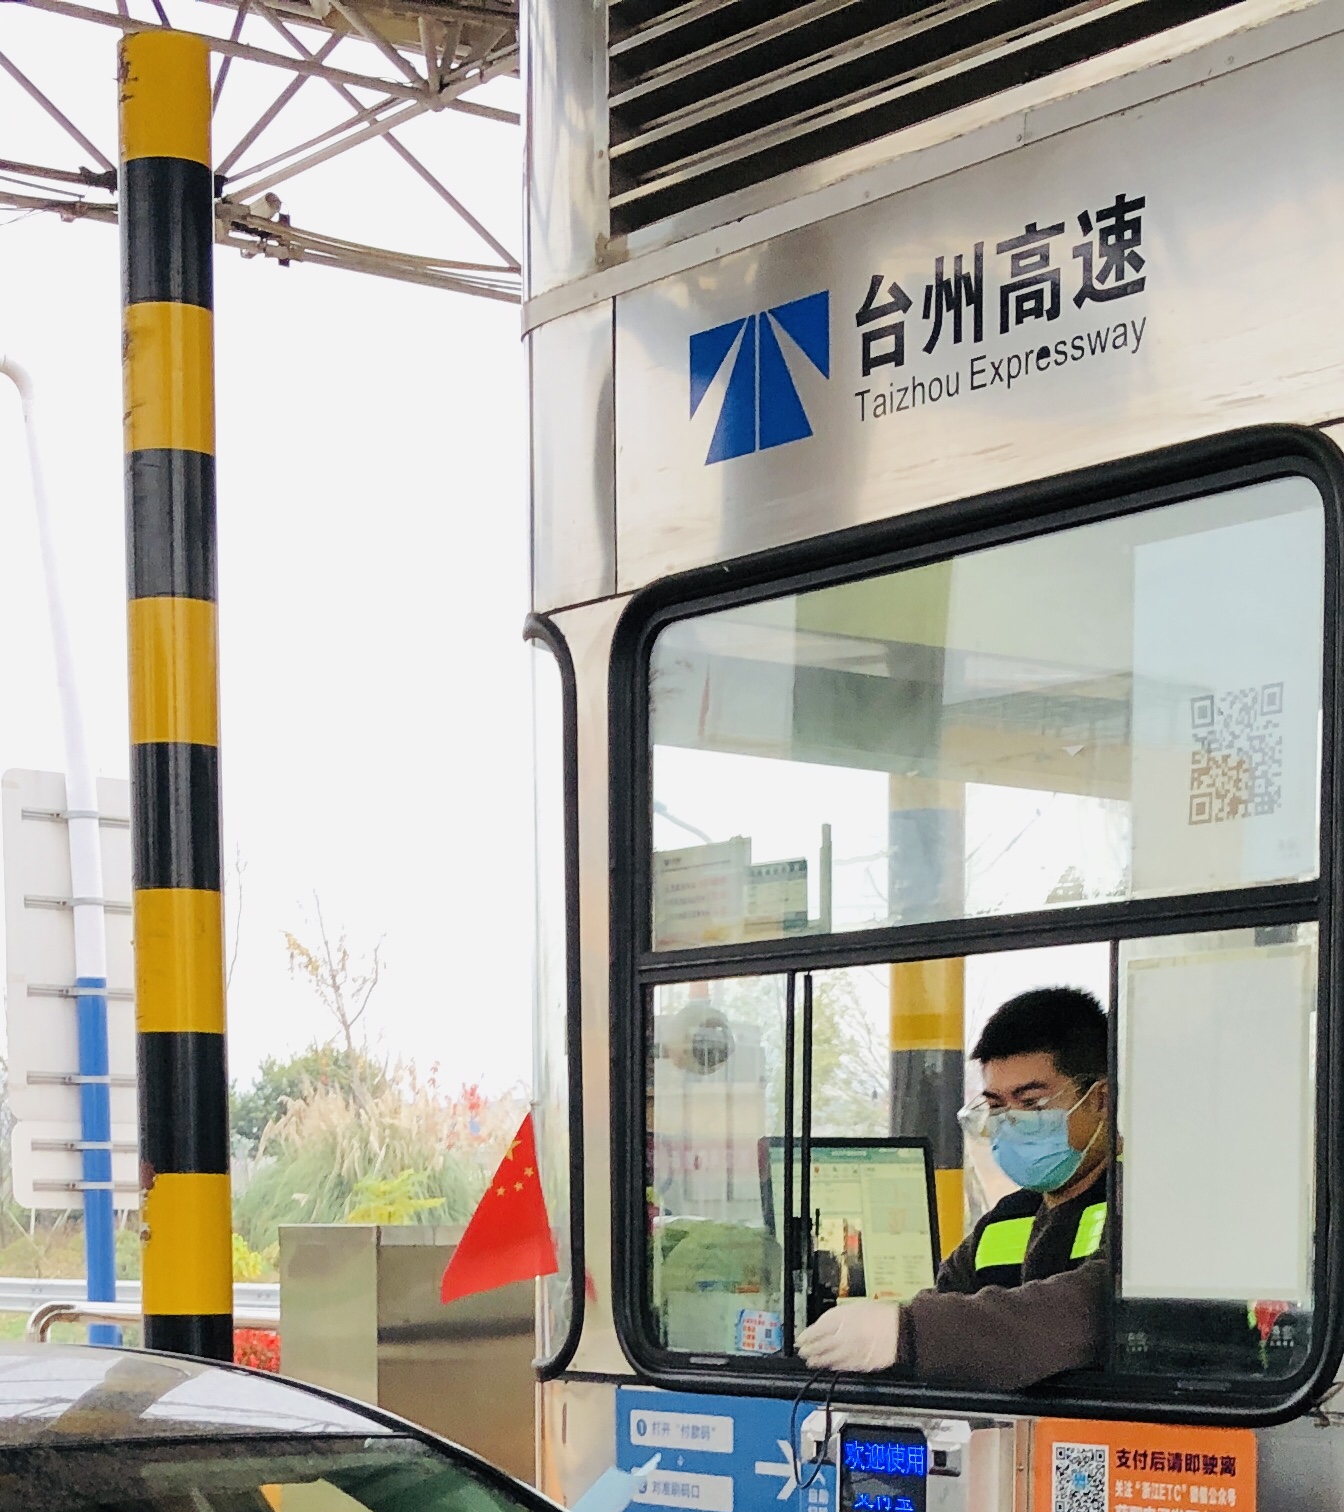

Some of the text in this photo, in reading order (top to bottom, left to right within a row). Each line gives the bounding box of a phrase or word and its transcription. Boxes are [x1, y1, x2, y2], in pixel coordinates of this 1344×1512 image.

[855, 193, 1146, 377] 台州高速
[855, 316, 1147, 422] Taizhou Expressway
[844, 1440, 925, 1476] 欢迎使用
[1115, 1448, 1236, 1478] 支付后请即驶离
